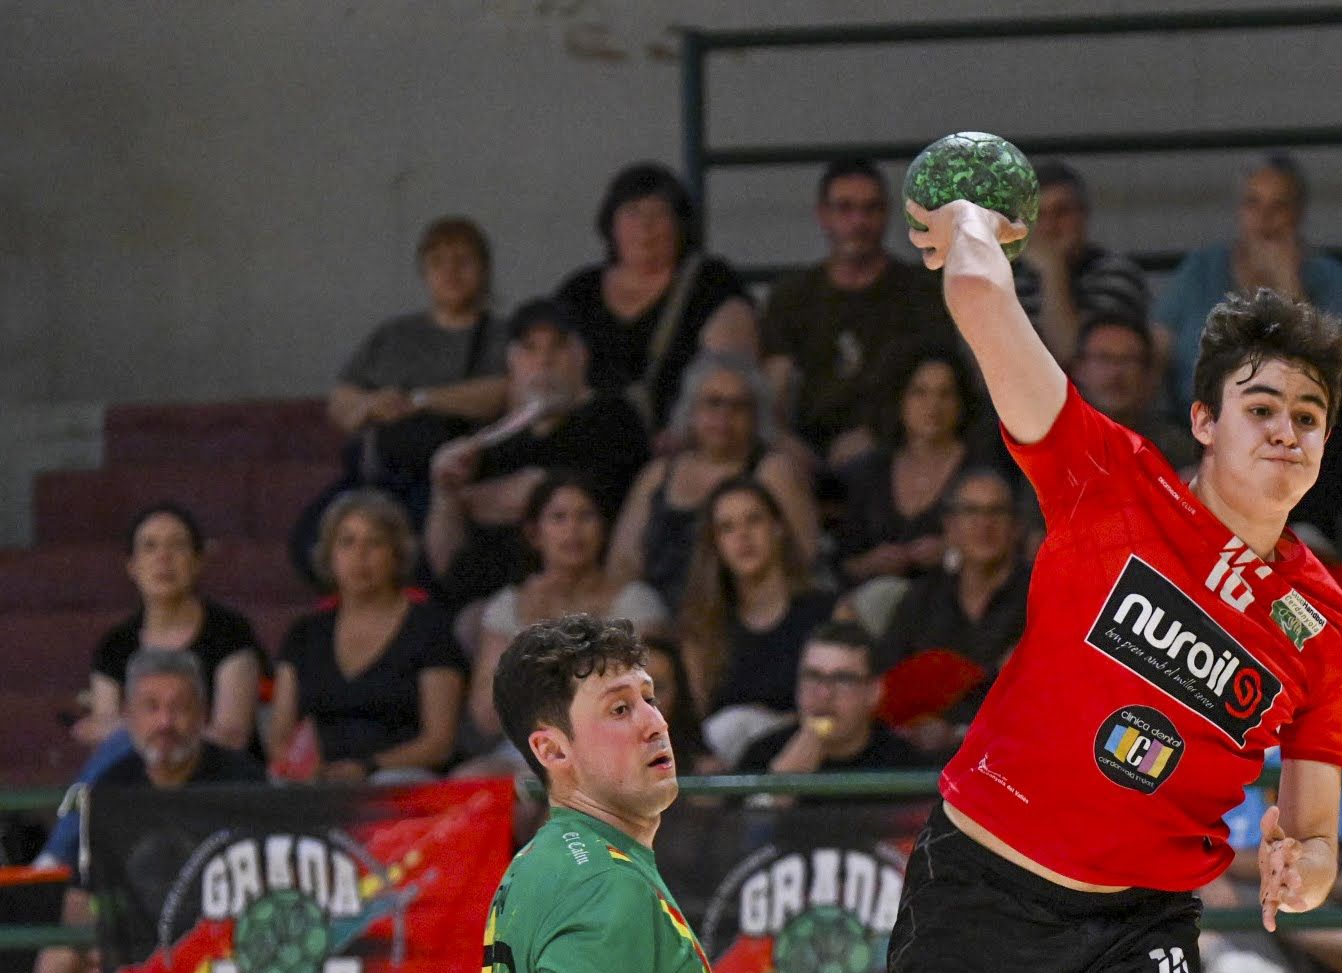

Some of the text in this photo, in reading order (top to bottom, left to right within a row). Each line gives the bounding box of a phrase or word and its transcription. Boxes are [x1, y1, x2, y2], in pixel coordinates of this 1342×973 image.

[1204, 535, 1273, 613] 16
[1113, 593, 1240, 697] nuroil
[1143, 655, 1169, 670] amb
[1164, 667, 1181, 678] el
[1151, 729, 1182, 748] dental
[202, 834, 362, 920] GRADA
